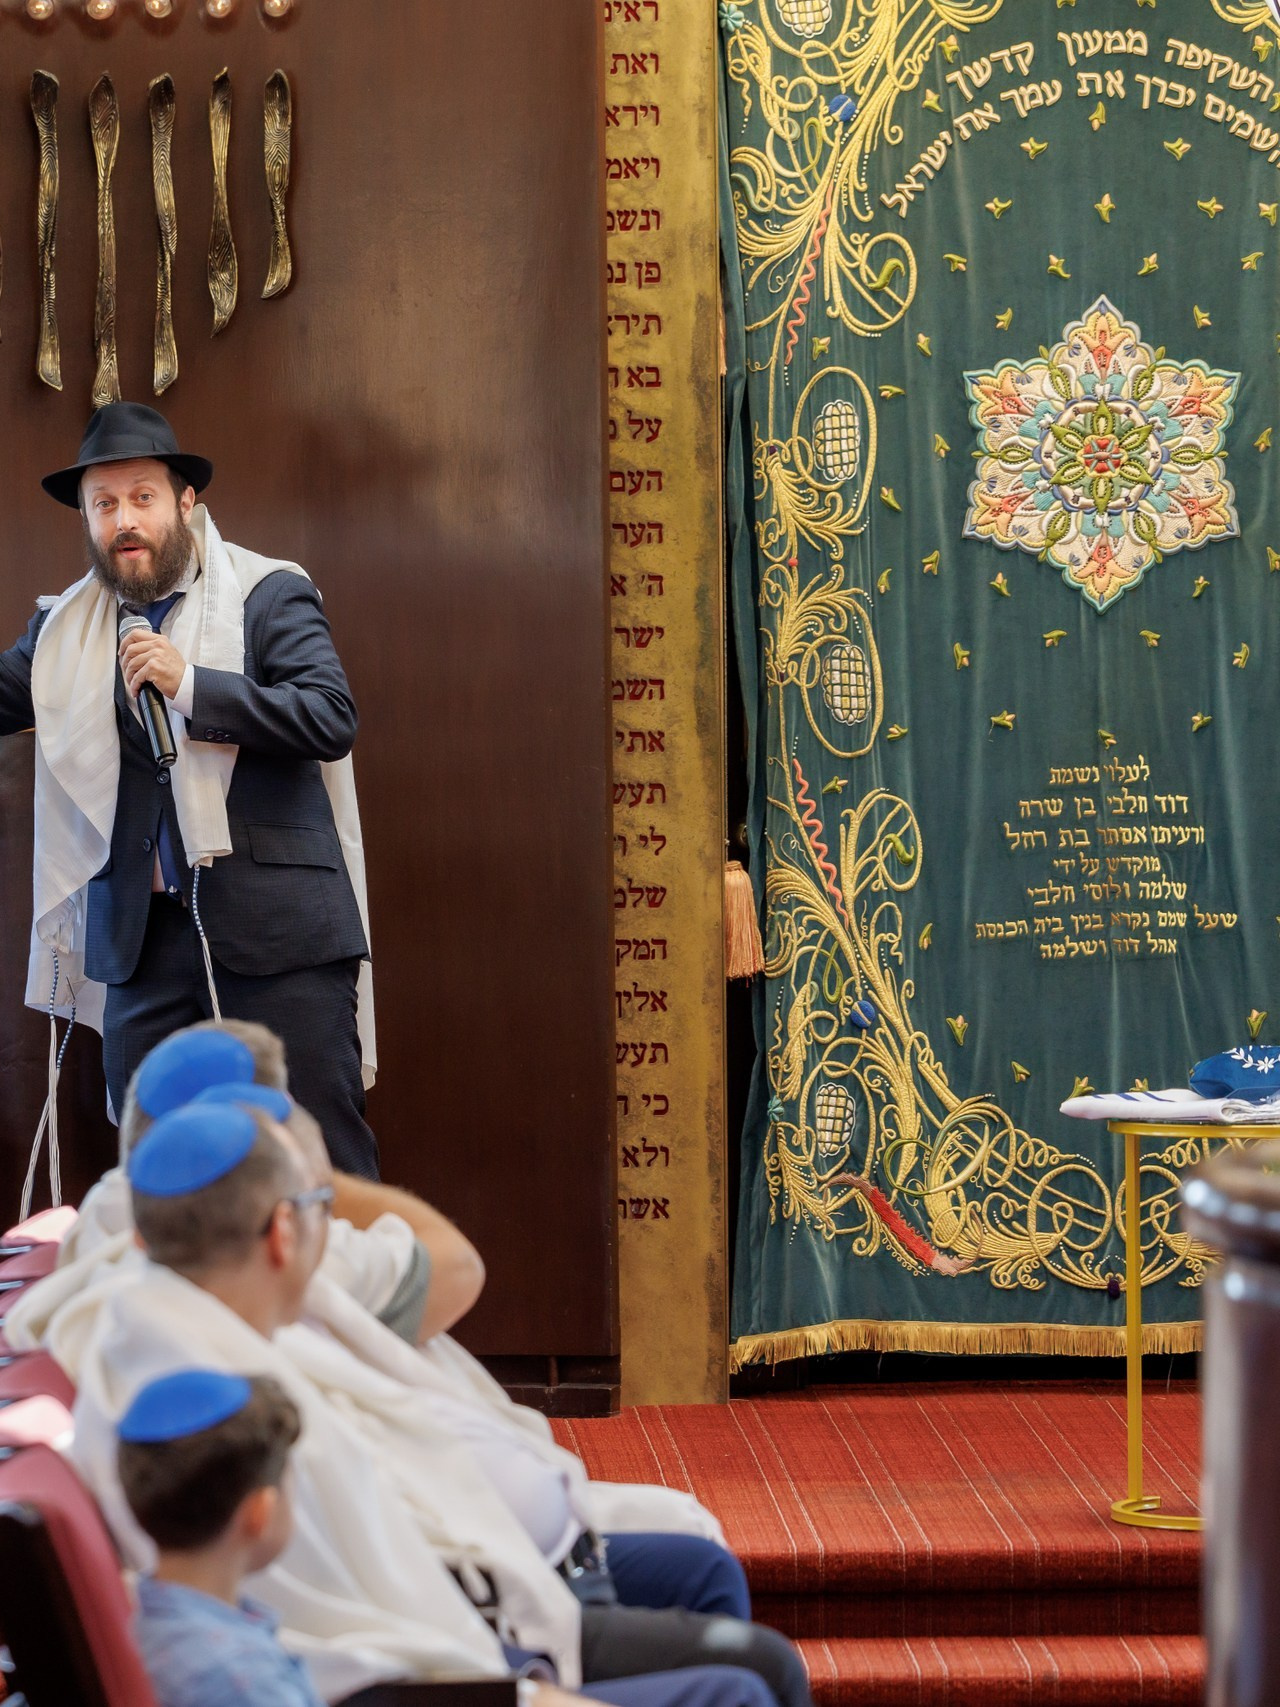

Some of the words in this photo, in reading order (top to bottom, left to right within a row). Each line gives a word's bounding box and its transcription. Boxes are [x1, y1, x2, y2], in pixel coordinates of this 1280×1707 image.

[1057, 28, 1148, 66] ממעון
[610, 53, 659, 74] ואת
[946, 42, 1034, 102] קדשך
[1164, 38, 1274, 102] השקיפה
[1077, 69, 1126, 99] את
[1000, 79, 1062, 118] עמך
[953, 102, 1001, 141] את
[880, 130, 953, 219] ישראל
[634, 261, 662, 290] פן
[627, 366, 662, 388] בא
[627, 410, 663, 443] על
[609, 470, 663, 496] העם
[612, 522, 664, 548] הער
[614, 626, 665, 648] ישר
[615, 730, 665, 752] אתי
[1049, 765, 1100, 785] נשמת
[1103, 754, 1150, 783] לעלוי
[1019, 797, 1063, 818] שרה
[1074, 797, 1097, 819] בן
[1107, 787, 1148, 815] חלבי
[1154, 794, 1189, 815] דוד
[640, 825, 667, 856] לי
[1003, 821, 1048, 850] רחל
[1058, 827, 1091, 848] בת
[1096, 825, 1148, 846] אסתר
[1151, 825, 1205, 846] ורעיתו
[1053, 858, 1076, 875] ידי
[1080, 851, 1100, 877] על
[1106, 855, 1161, 878] מוקדש
[1027, 879, 1076, 906] חלבי
[1139, 873, 1187, 900] שלמה
[975, 920, 1029, 938] הכנסת
[1034, 916, 1065, 934] בית
[1111, 911, 1150, 931] נקרא
[1193, 903, 1238, 930] שעל
[615, 938, 667, 967] המק
[1040, 934, 1108, 959] ושלמה
[1113, 937, 1140, 955] דוד
[1146, 930, 1177, 954] אהל
[642, 1094, 670, 1116] כי
[622, 1137, 670, 1167] ולא
